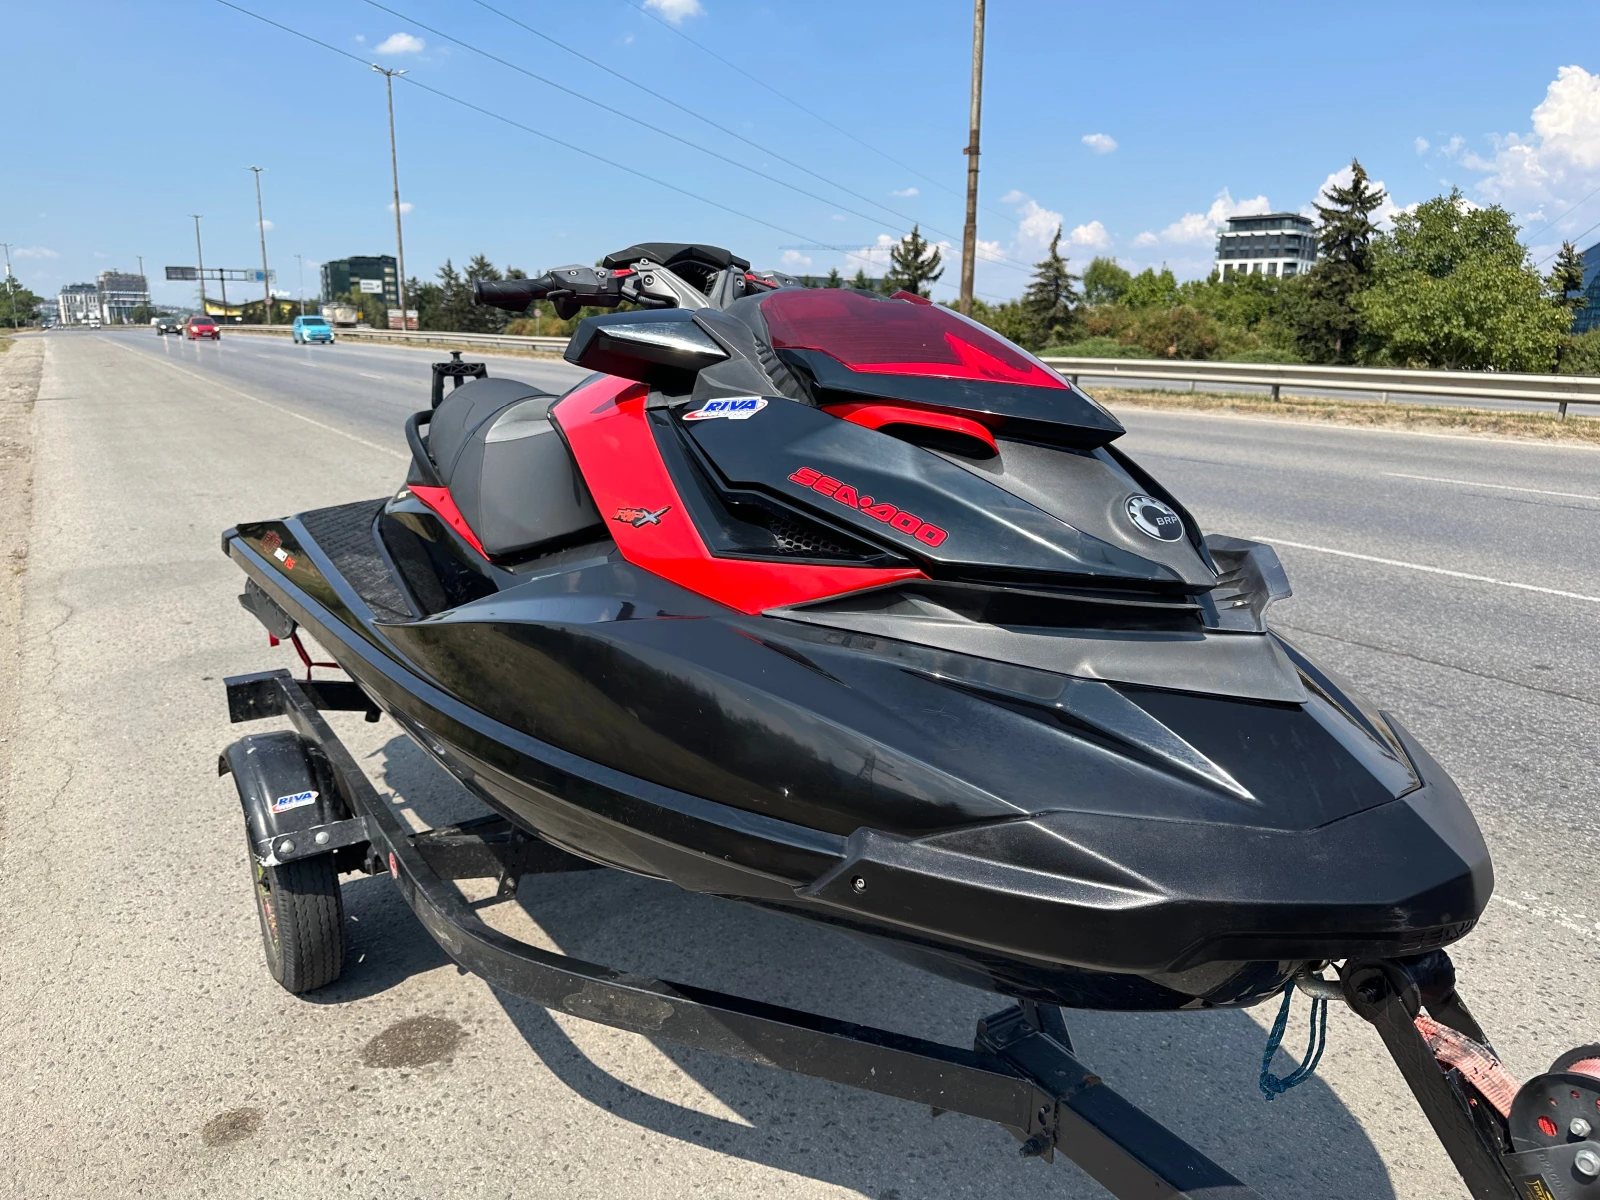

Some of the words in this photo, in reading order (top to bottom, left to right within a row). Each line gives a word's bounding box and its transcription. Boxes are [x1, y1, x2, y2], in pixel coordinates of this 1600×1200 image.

[704, 399, 757, 412] RIVA
[1156, 516, 1178, 526] BRP
[279, 793, 312, 805] RIVA
